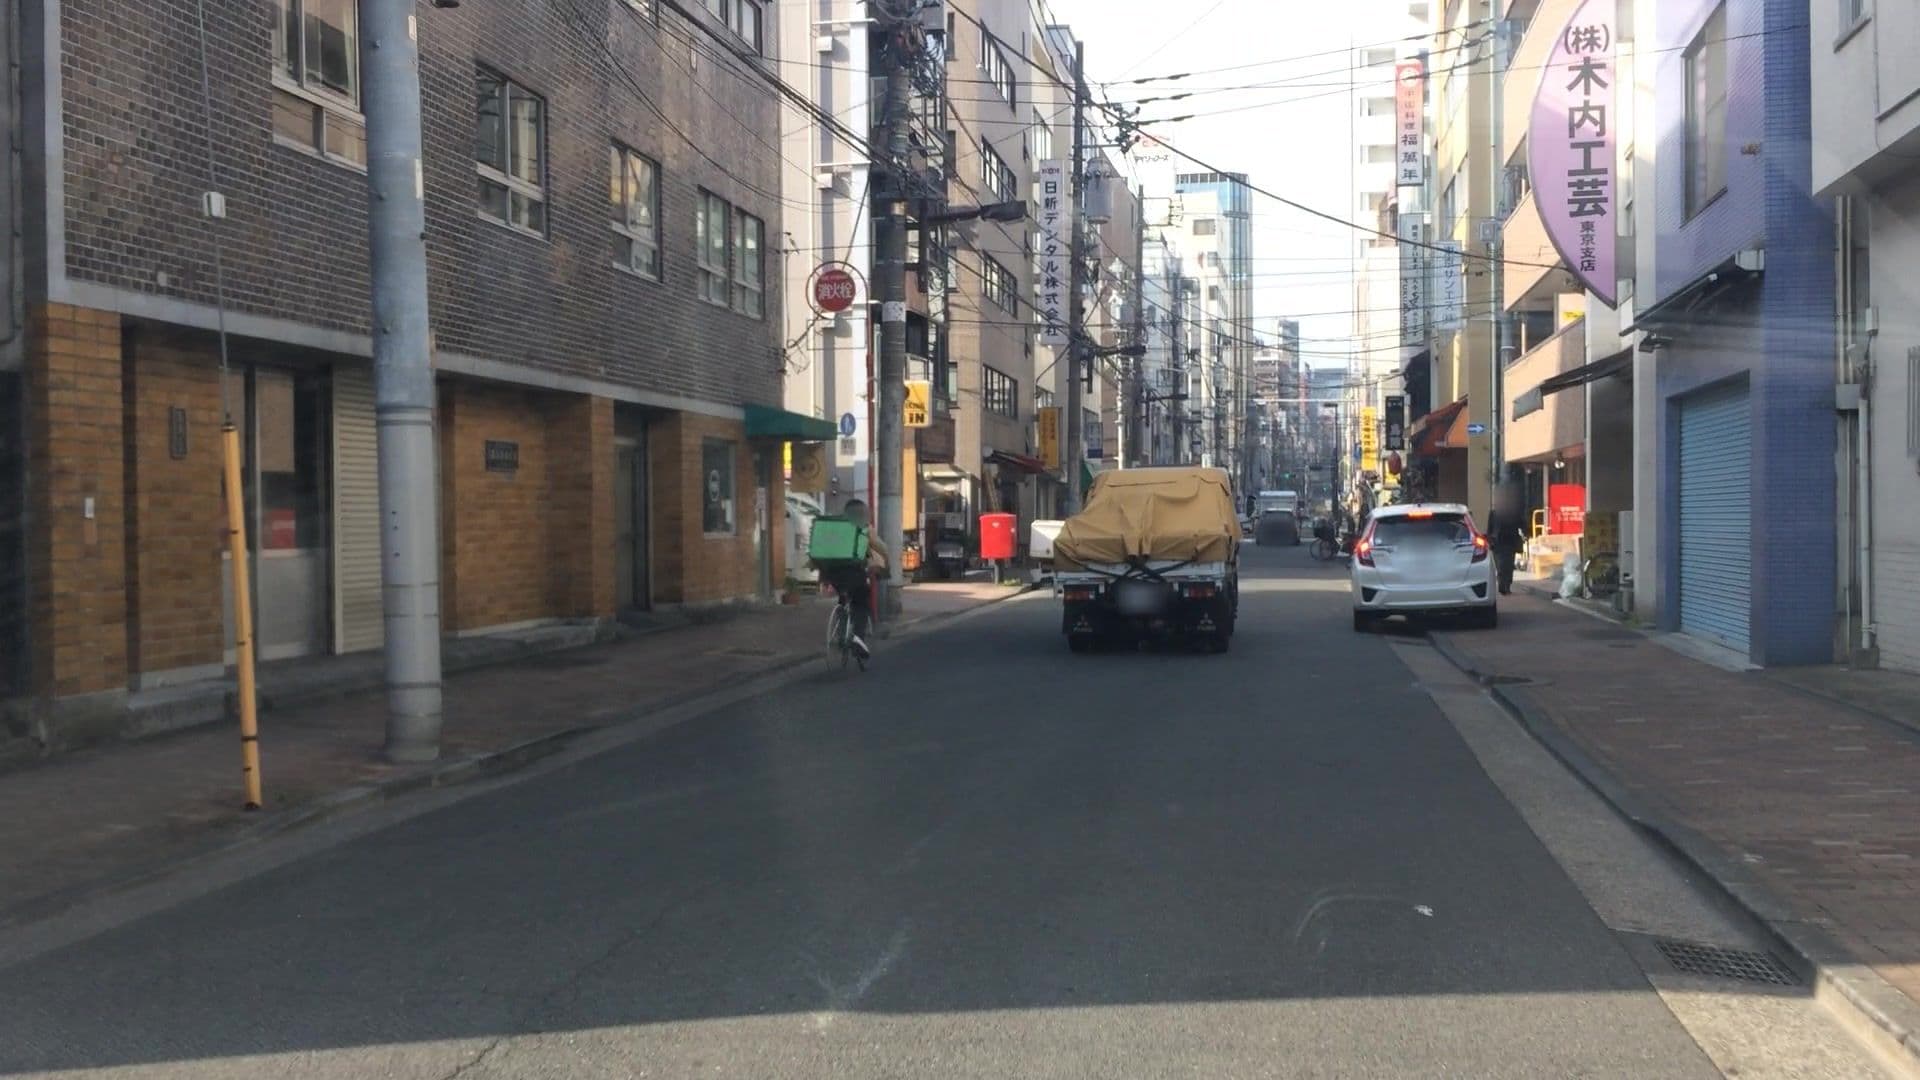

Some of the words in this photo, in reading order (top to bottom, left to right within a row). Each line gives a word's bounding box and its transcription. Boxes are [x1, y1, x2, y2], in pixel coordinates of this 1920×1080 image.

[1564, 23, 1610, 218] (株)木内工芸
[818, 282, 852, 299] 消火栓
[1044, 181, 1059, 337] 日新デンタル株式会社
[1579, 221, 1596, 272] 東京支店
